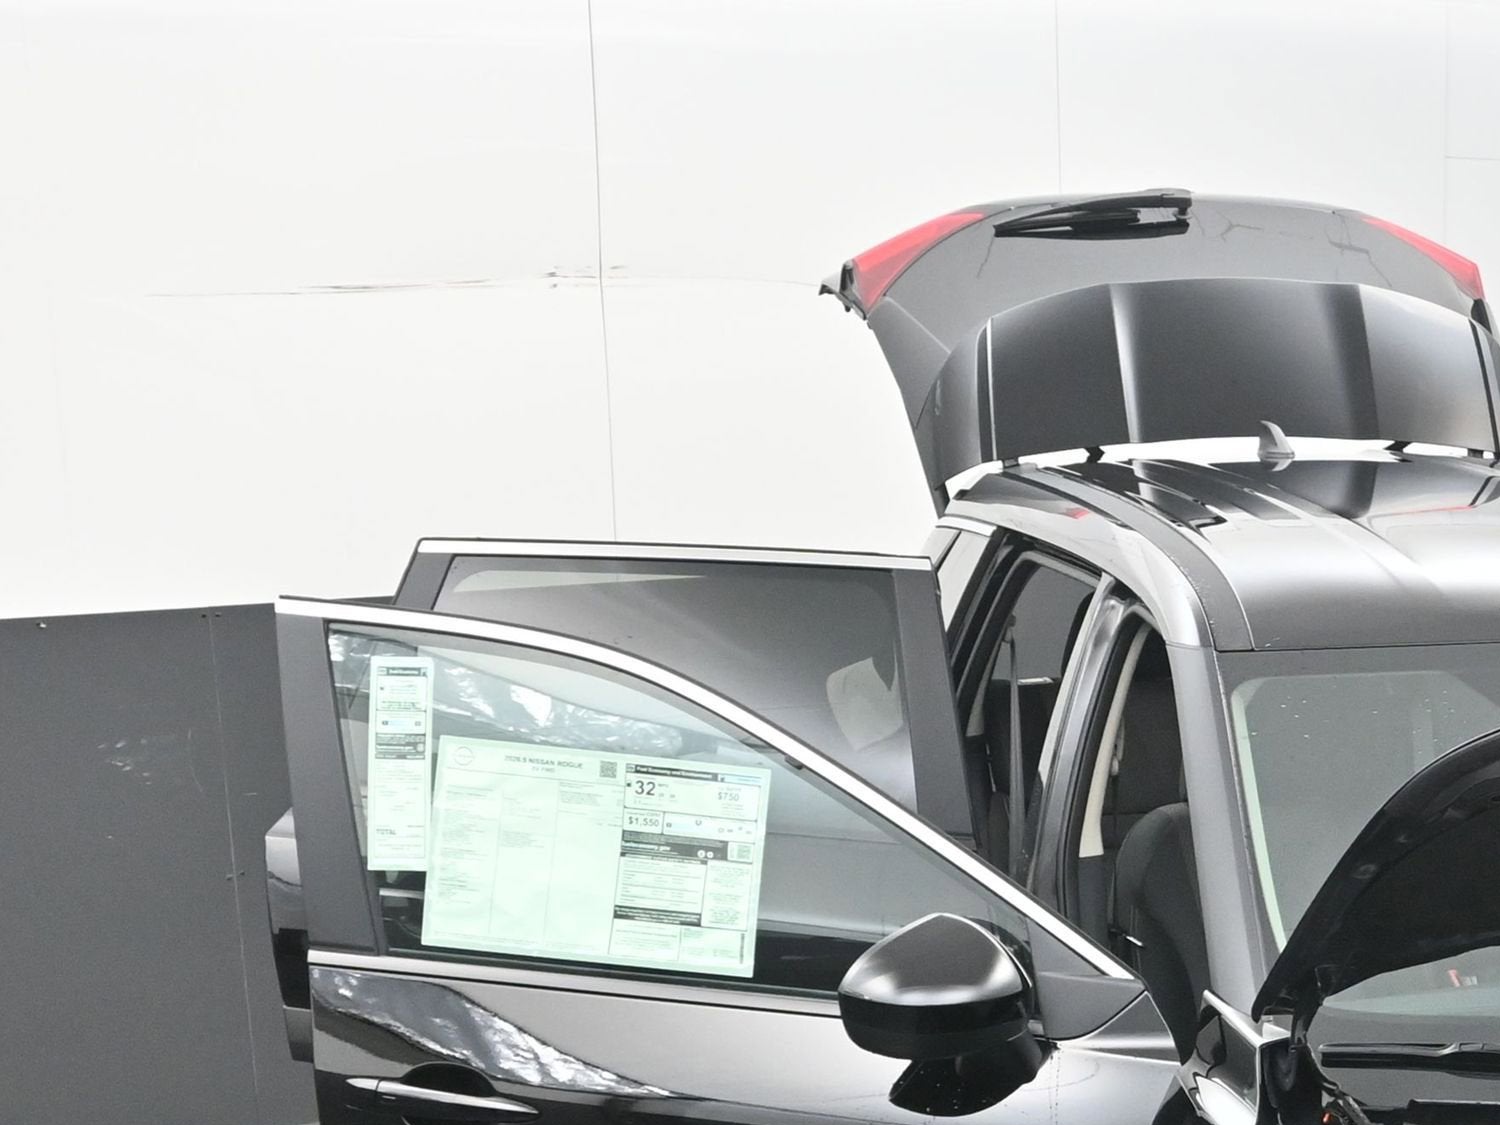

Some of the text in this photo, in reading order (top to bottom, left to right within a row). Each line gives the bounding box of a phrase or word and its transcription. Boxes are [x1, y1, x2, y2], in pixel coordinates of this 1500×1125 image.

[529, 758, 555, 766] NISSAN
[557, 760, 583, 769] ROGUE
[635, 780, 656, 796] 32
[718, 791, 740, 802] $750
[628, 816, 659, 828] $1,550
